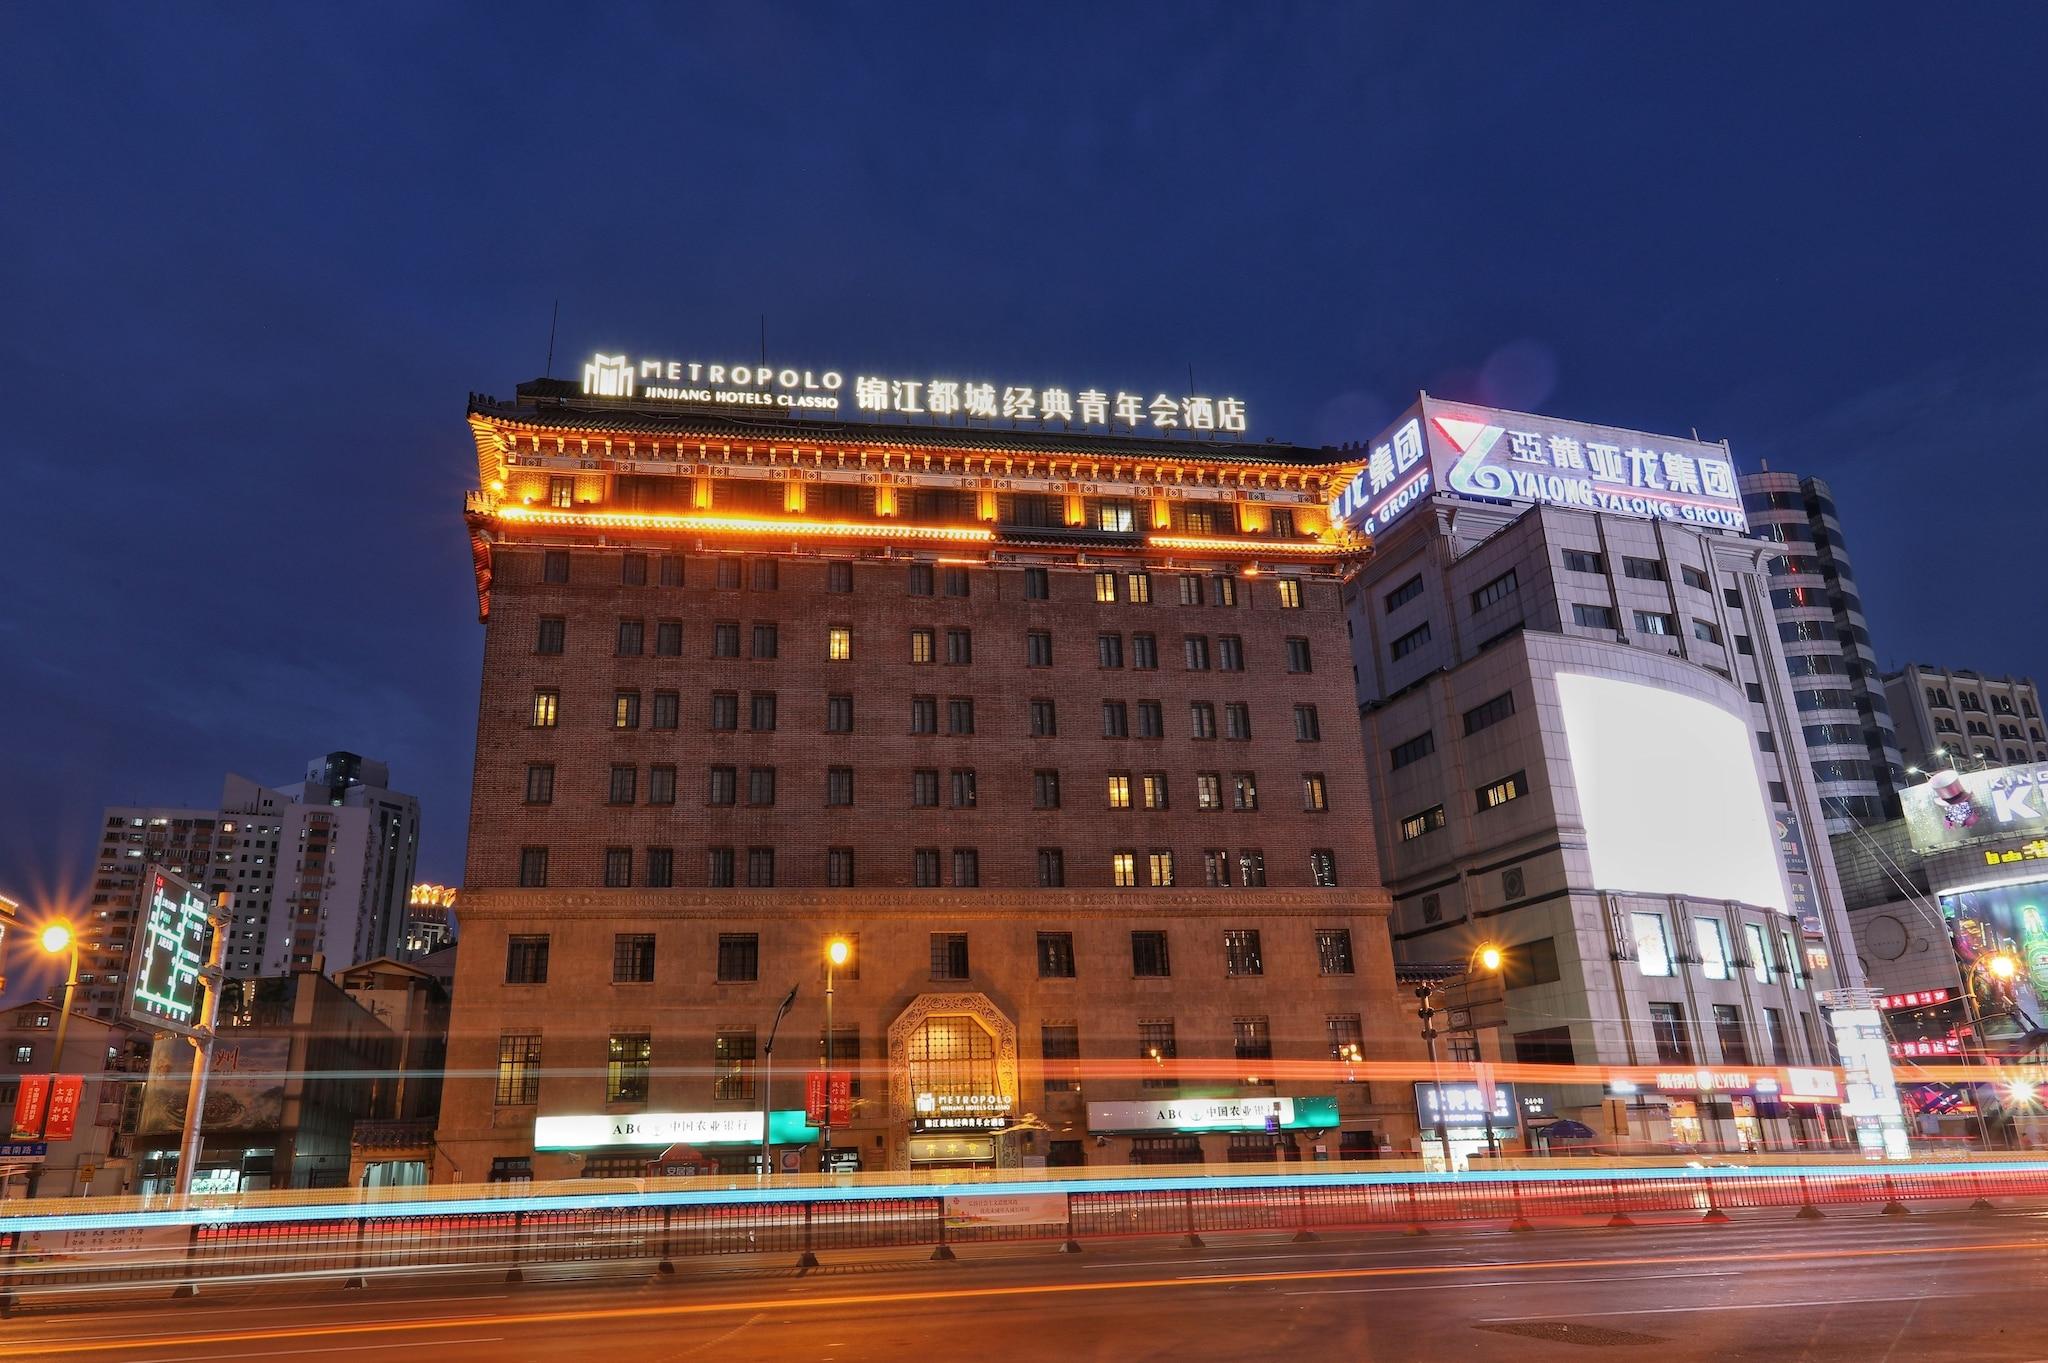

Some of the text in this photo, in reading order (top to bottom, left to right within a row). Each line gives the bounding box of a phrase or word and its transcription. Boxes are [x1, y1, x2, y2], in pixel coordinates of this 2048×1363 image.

[640, 360, 843, 390] METROPOLO
[645, 386, 712, 402] JINJIANG
[715, 391, 772, 406] HOTELS
[855, 375, 1247, 431] 锦江都城经典青年会酒店
[1512, 468, 1594, 507] YALONG
[1585, 441, 1737, 500] 亚龙集团
[1379, 473, 1430, 523] GROUP
[1595, 492, 1744, 528] YALONG GROUP
[938, 1095, 1012, 1105] METROPOLO
